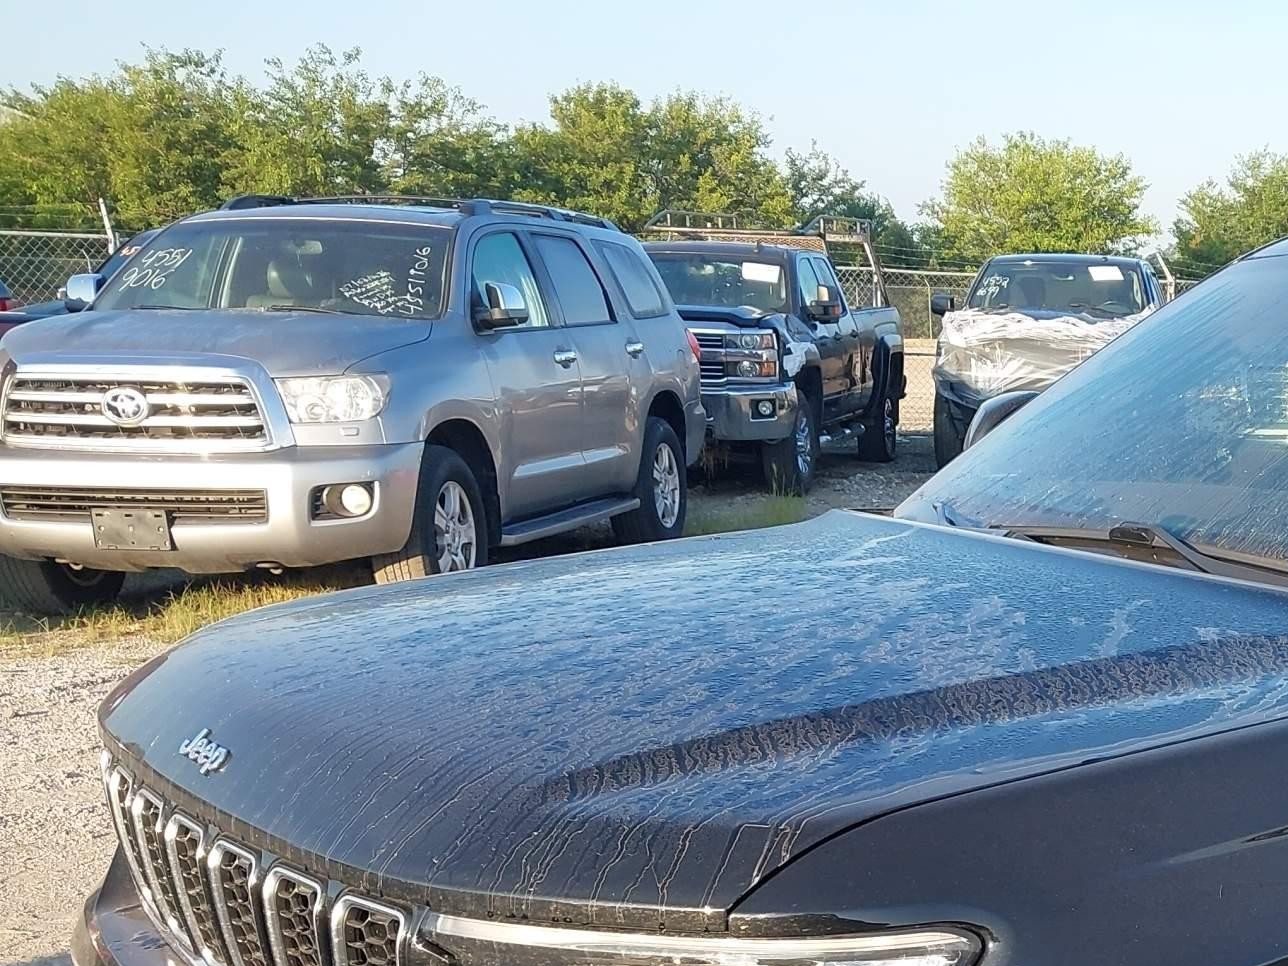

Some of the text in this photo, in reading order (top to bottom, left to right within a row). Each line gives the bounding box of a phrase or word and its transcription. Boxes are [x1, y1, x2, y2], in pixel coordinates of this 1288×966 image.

[141, 248, 193, 269] 4551
[119, 267, 176, 290] 9016
[178, 727, 227, 775] Jeep
